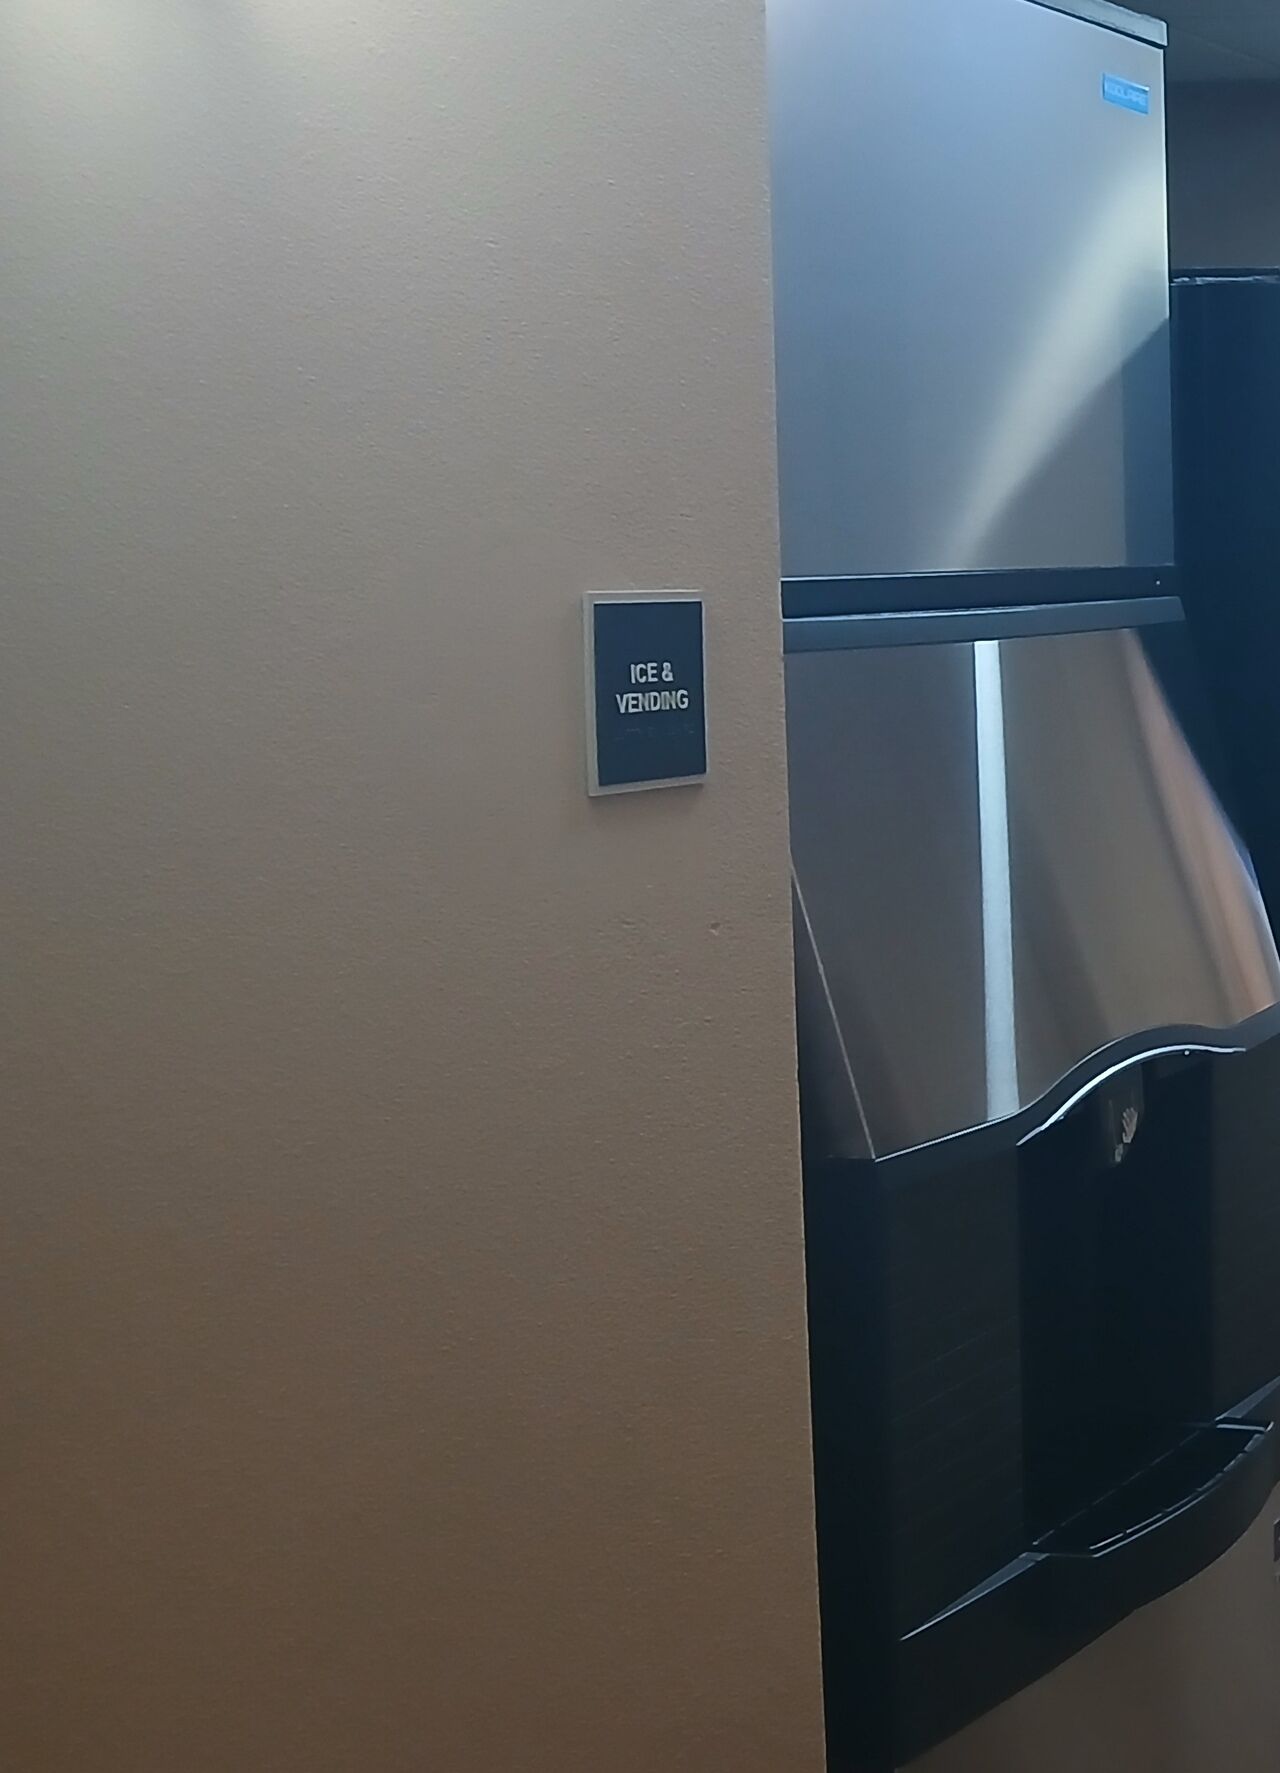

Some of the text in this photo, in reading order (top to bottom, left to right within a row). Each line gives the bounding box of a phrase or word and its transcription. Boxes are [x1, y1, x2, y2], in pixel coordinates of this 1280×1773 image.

[630, 662, 674, 684] ICE &
[615, 689, 689, 714] VENDING
